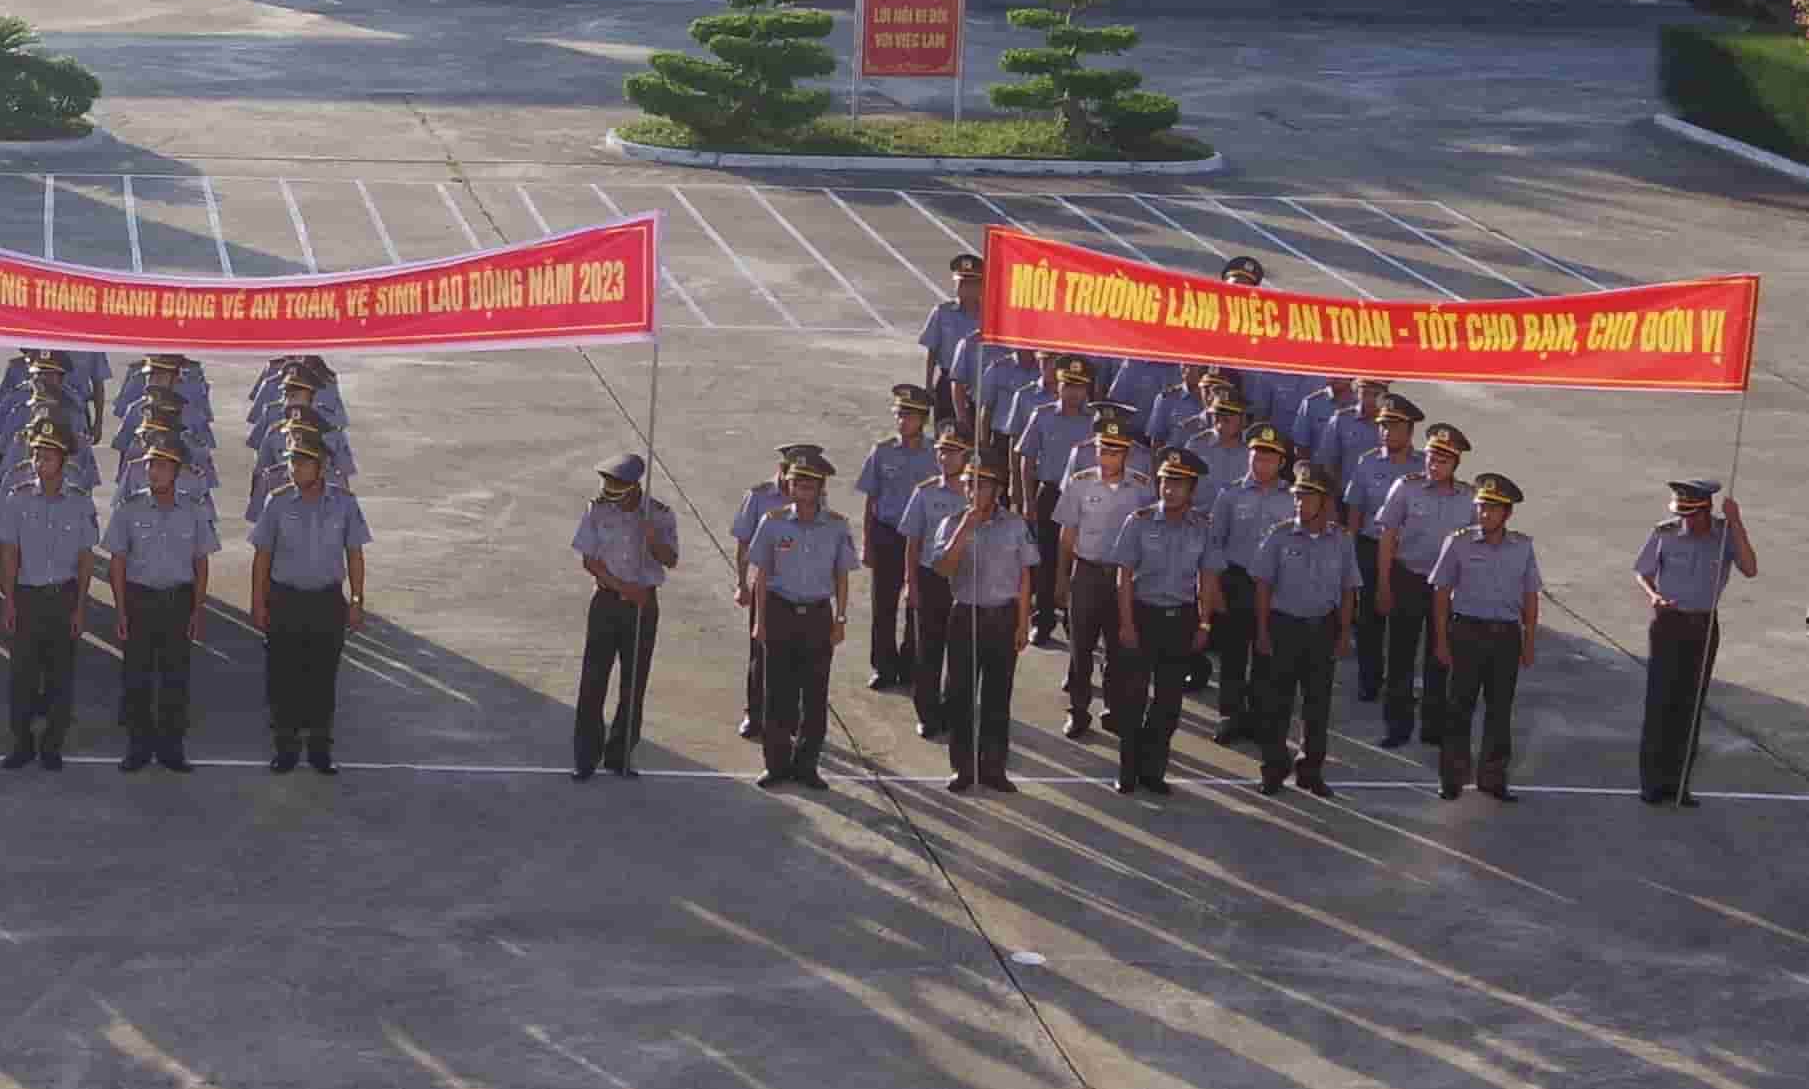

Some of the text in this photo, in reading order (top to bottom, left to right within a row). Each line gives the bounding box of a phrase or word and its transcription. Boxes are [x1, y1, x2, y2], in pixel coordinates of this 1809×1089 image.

[35, 276, 97, 314] THÁNG
[102, 285, 157, 318] HÀNH
[160, 287, 217, 328] ĐỘNG
[221, 287, 247, 320] VỀ
[250, 294, 279, 320] AN
[285, 288, 341, 328] TOÀN,
[346, 283, 370, 327] VỆ
[375, 280, 422, 317] SINH
[427, 273, 463, 313] LAO
[469, 265, 523, 320] ĐỘNG
[527, 257, 574, 306] NĂM
[578, 260, 625, 304] 2023
[1010, 258, 1060, 311] MÔI
[1063, 268, 1163, 324] TRƯỜNG
[1165, 280, 1220, 332] LÀM
[1225, 291, 1282, 345] VIỆC
[1287, 302, 1323, 345] AN
[1325, 297, 1394, 349] TOÀN
[1413, 302, 1459, 352] TỐT
[1465, 312, 1518, 352] CHO
[1522, 312, 1580, 361] BẠN,
[1586, 311, 1638, 352] CHO
[1640, 306, 1694, 353] ĐƠN
[1701, 309, 1727, 365] VỊ
